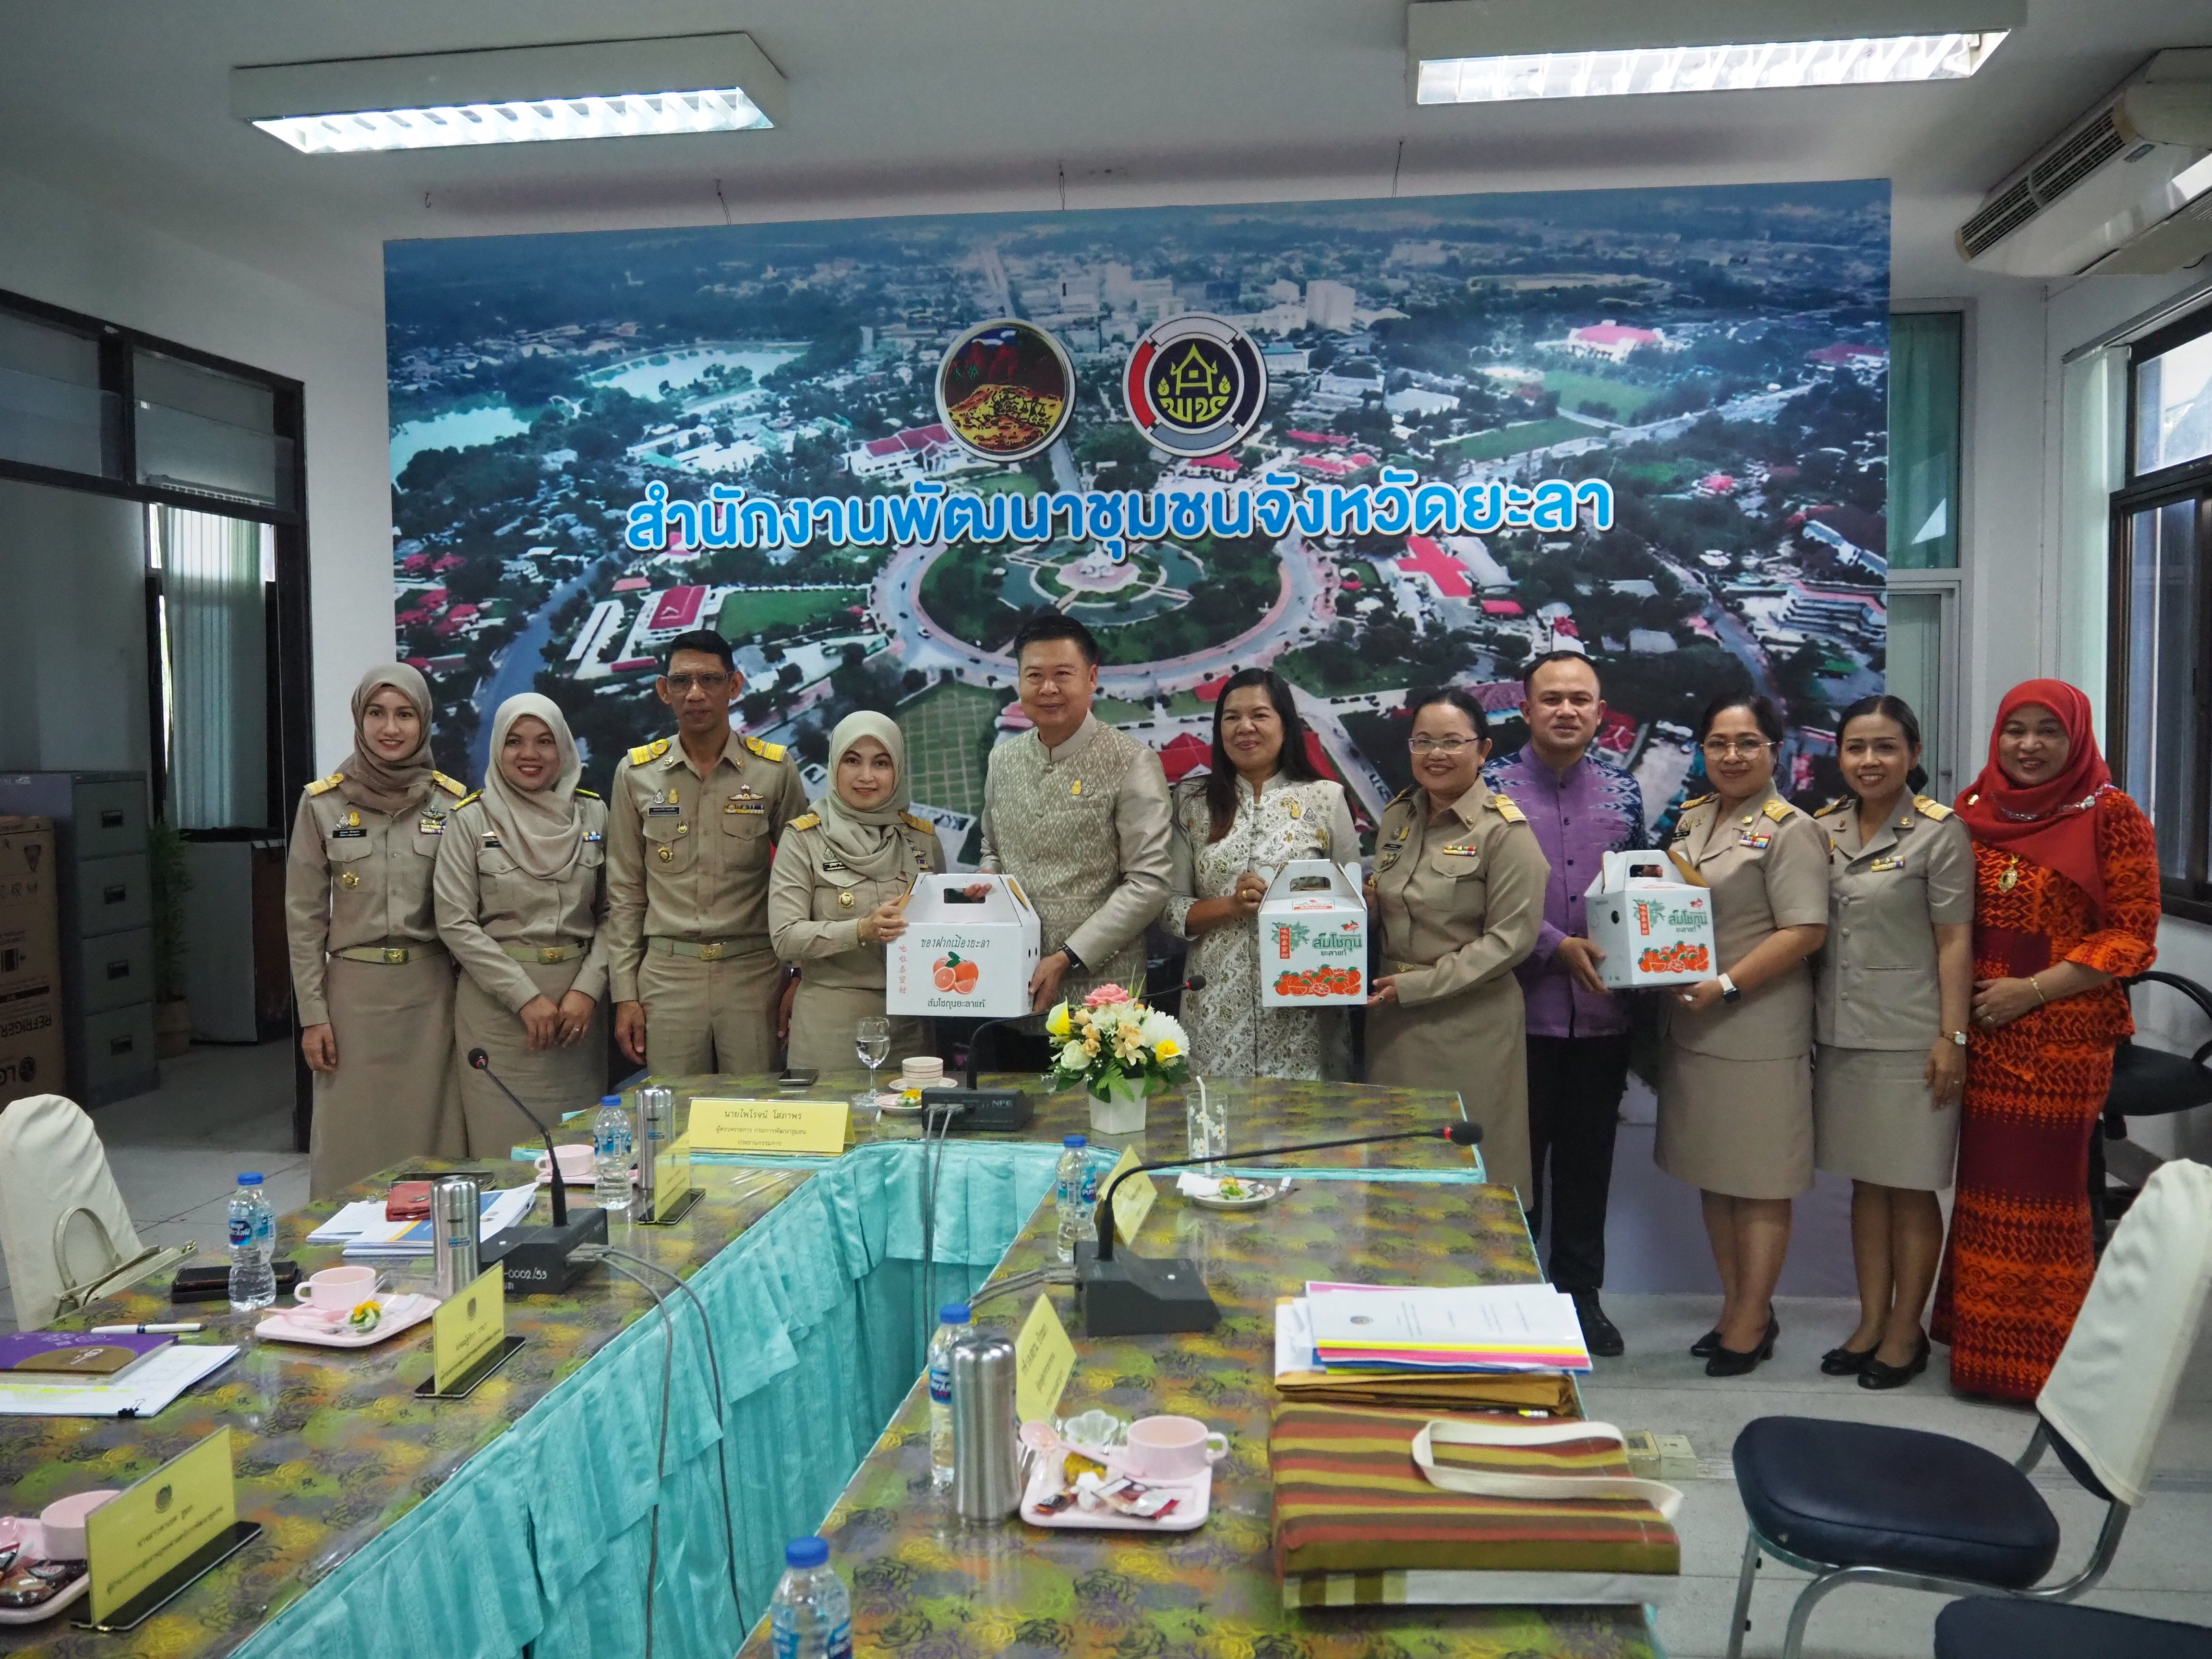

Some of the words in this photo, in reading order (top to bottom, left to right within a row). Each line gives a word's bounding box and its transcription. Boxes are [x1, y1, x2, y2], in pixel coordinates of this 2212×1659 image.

[625, 469, 1614, 563] สำนักงานพัฒนาชุมชนจังหวัดยะลา
[1312, 933, 1363, 953] ส้มโชกุน
[927, 998, 986, 1009] ส้มโชกุนยะลาแท้
[724, 1109, 768, 1118] นายไพโรจน์
